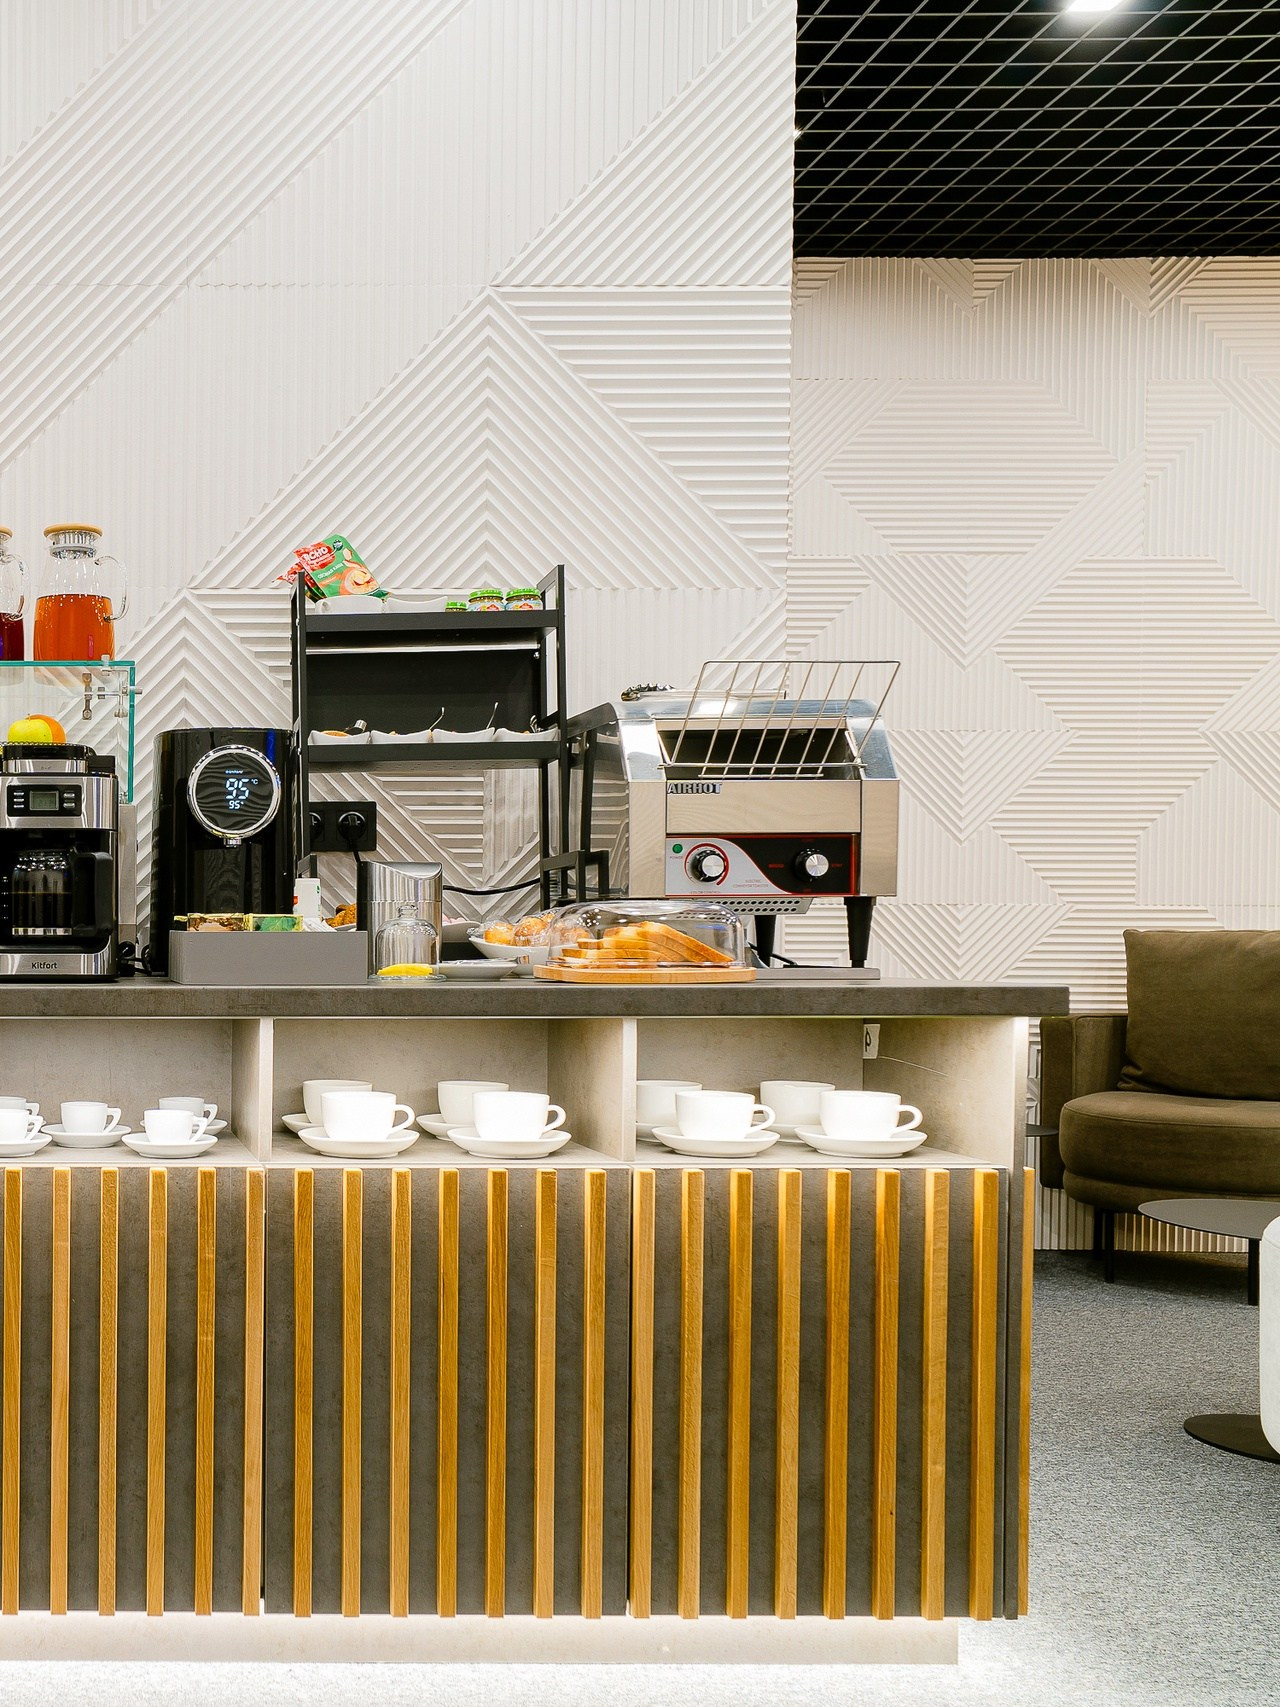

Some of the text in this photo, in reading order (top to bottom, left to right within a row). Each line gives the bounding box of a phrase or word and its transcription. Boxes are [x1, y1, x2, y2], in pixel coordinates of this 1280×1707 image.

[225, 778, 250, 800] 95
[667, 782, 722, 794] AIRHOT
[31, 961, 58, 969] Kitfort
